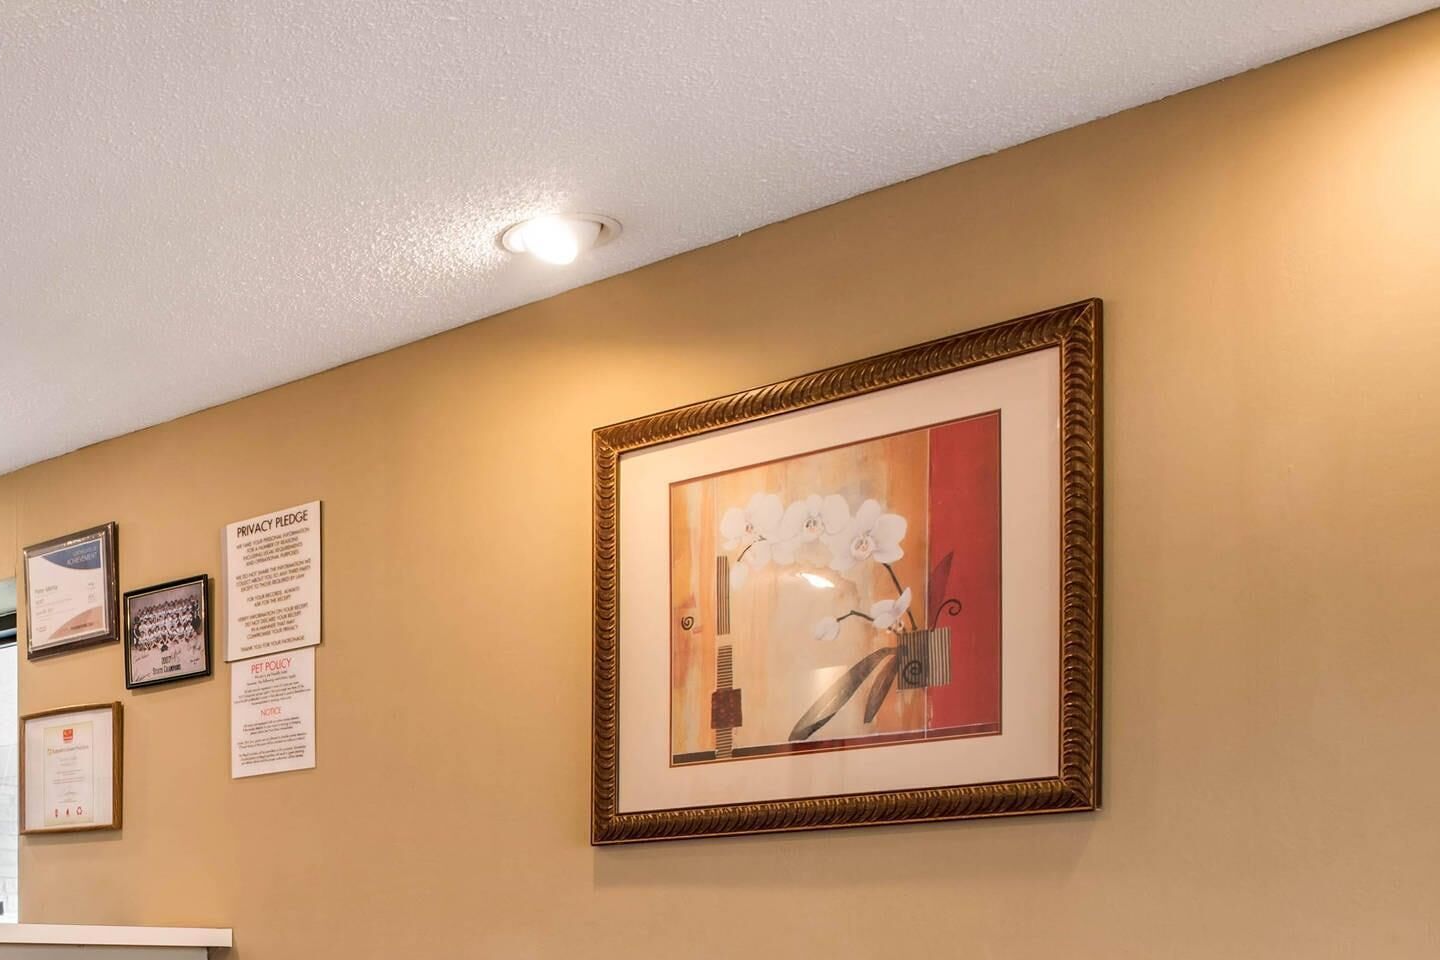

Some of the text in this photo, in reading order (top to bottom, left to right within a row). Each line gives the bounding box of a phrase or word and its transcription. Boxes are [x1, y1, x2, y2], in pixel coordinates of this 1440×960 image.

[237, 510, 308, 538] PRIVACY PLEDGE
[251, 659, 292, 674] PET POLICY
